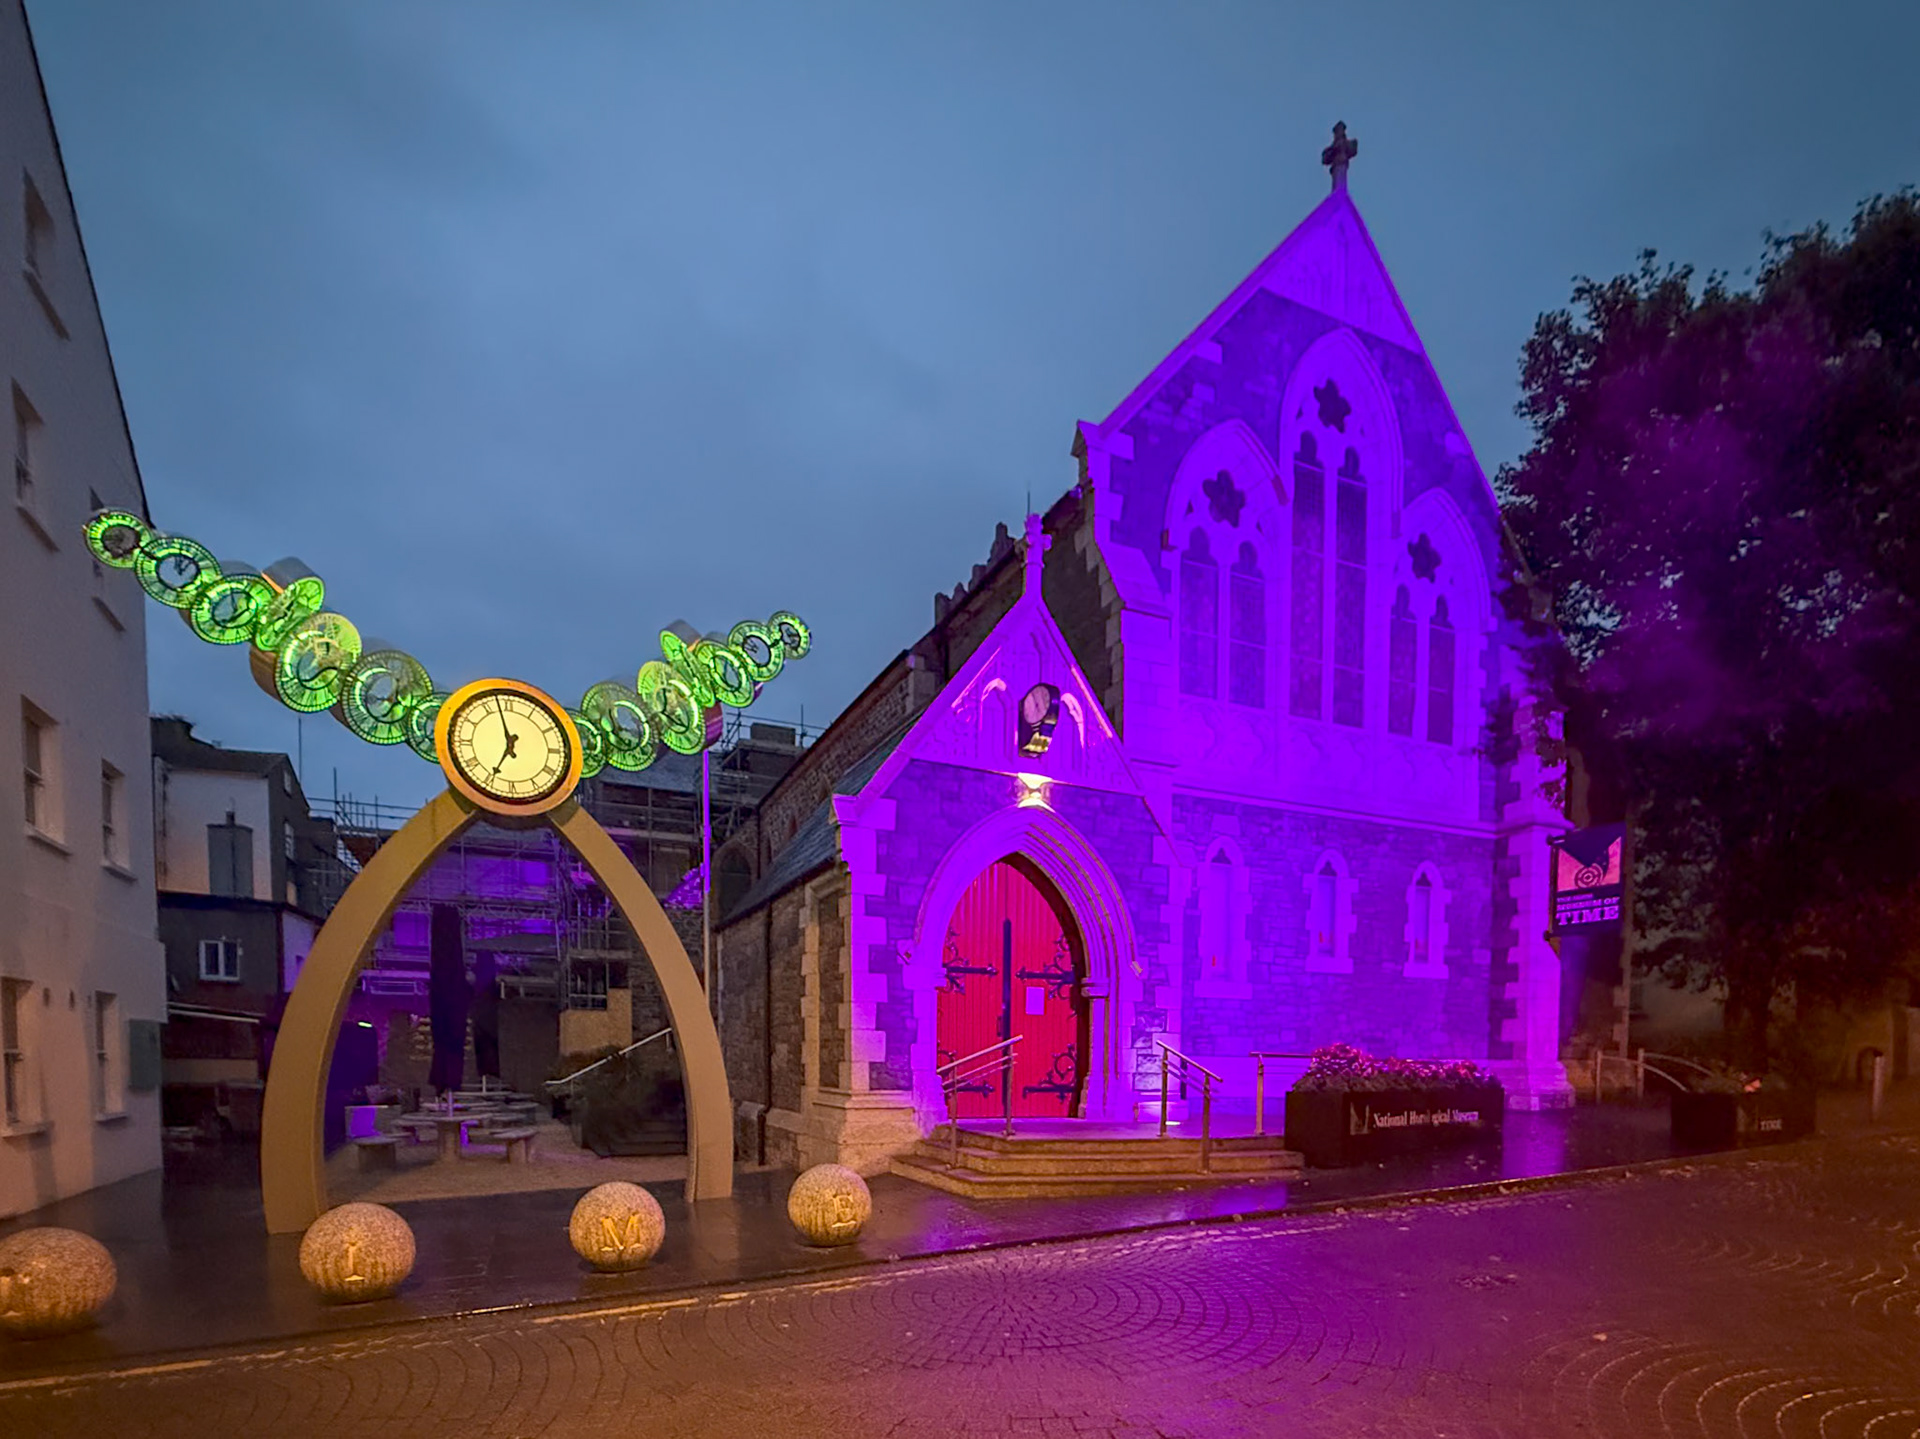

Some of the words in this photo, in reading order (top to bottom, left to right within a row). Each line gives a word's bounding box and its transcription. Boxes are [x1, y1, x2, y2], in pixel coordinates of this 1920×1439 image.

[1555, 905, 1619, 925] TIME
[1373, 1111, 1408, 1128] National
[1409, 1108, 1450, 1127] Horolgical
[600, 1212, 646, 1252] M
